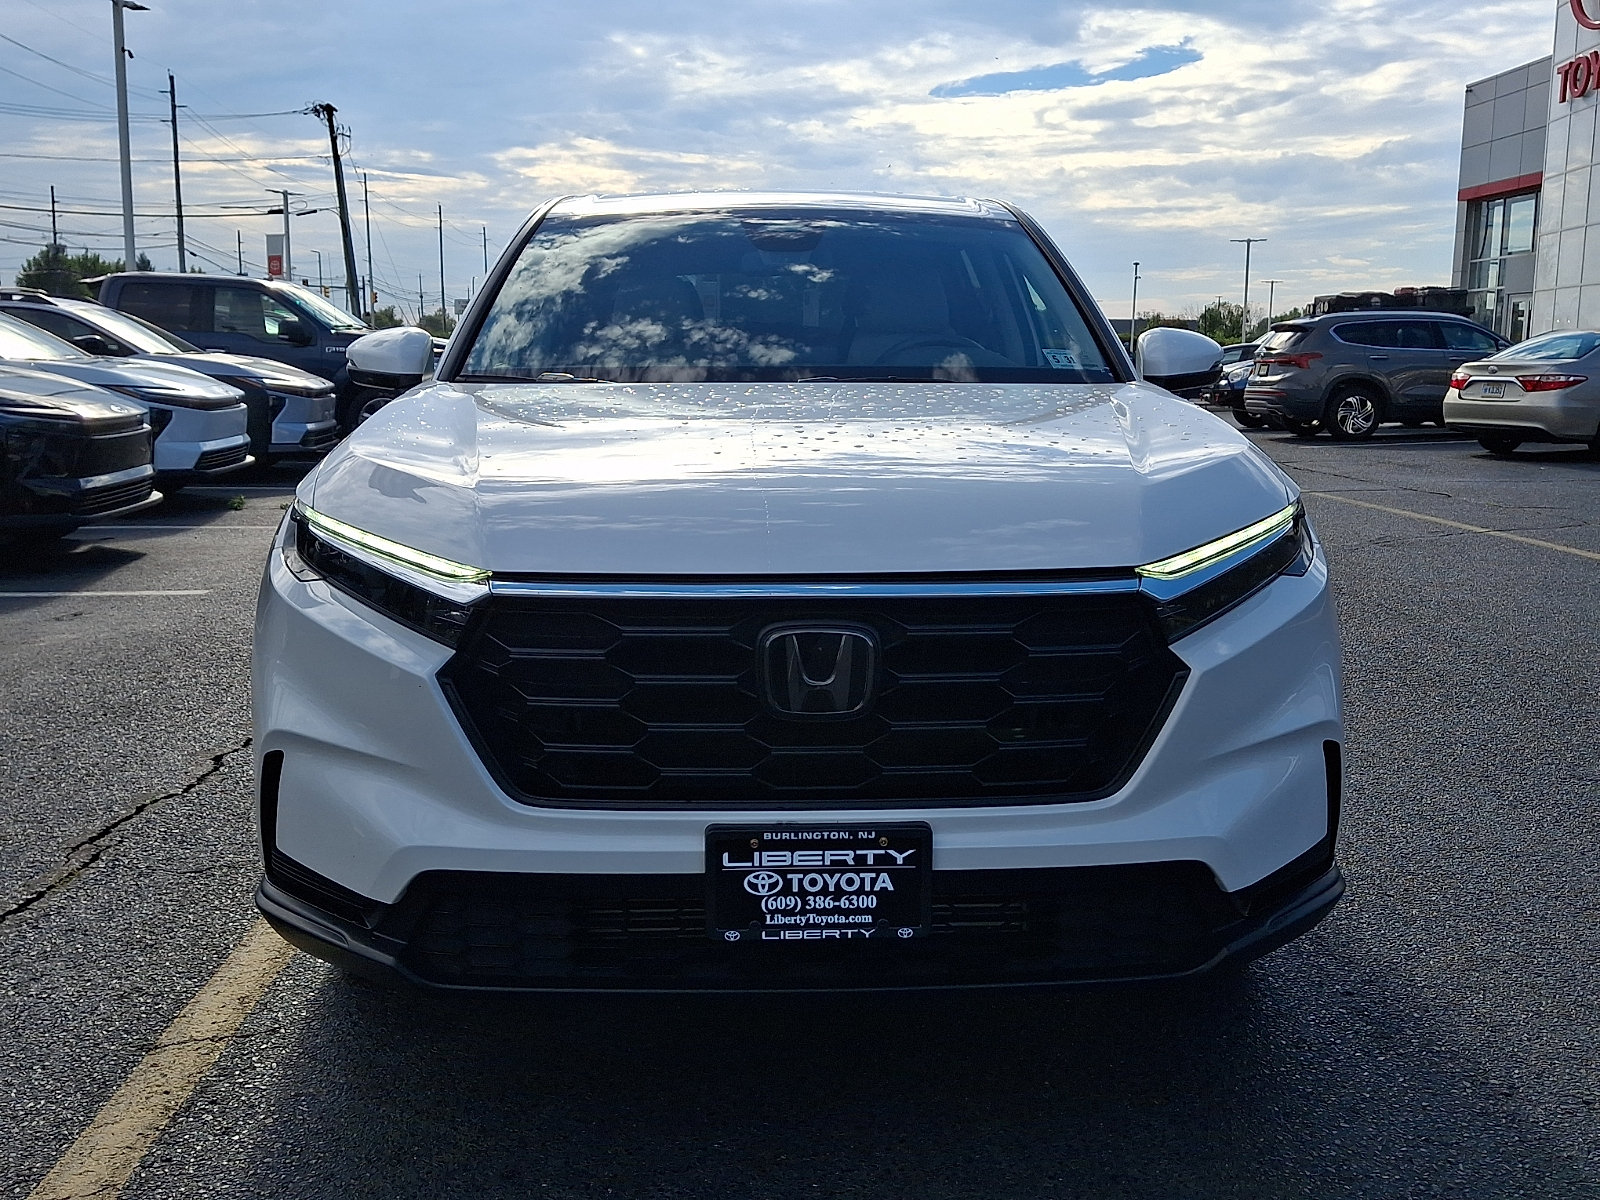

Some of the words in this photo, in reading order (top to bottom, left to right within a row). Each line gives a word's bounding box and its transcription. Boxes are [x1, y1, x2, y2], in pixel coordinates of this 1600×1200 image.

[858, 831, 876, 839] NJ
[722, 849, 916, 867] LIBERTY
[786, 872, 895, 893] TOYOTA
[761, 896, 802, 913] (609)
[805, 895, 877, 909] 386-6300
[765, 914, 873, 925] LibertyToyota.com
[761, 928, 876, 940] LIBERTY
